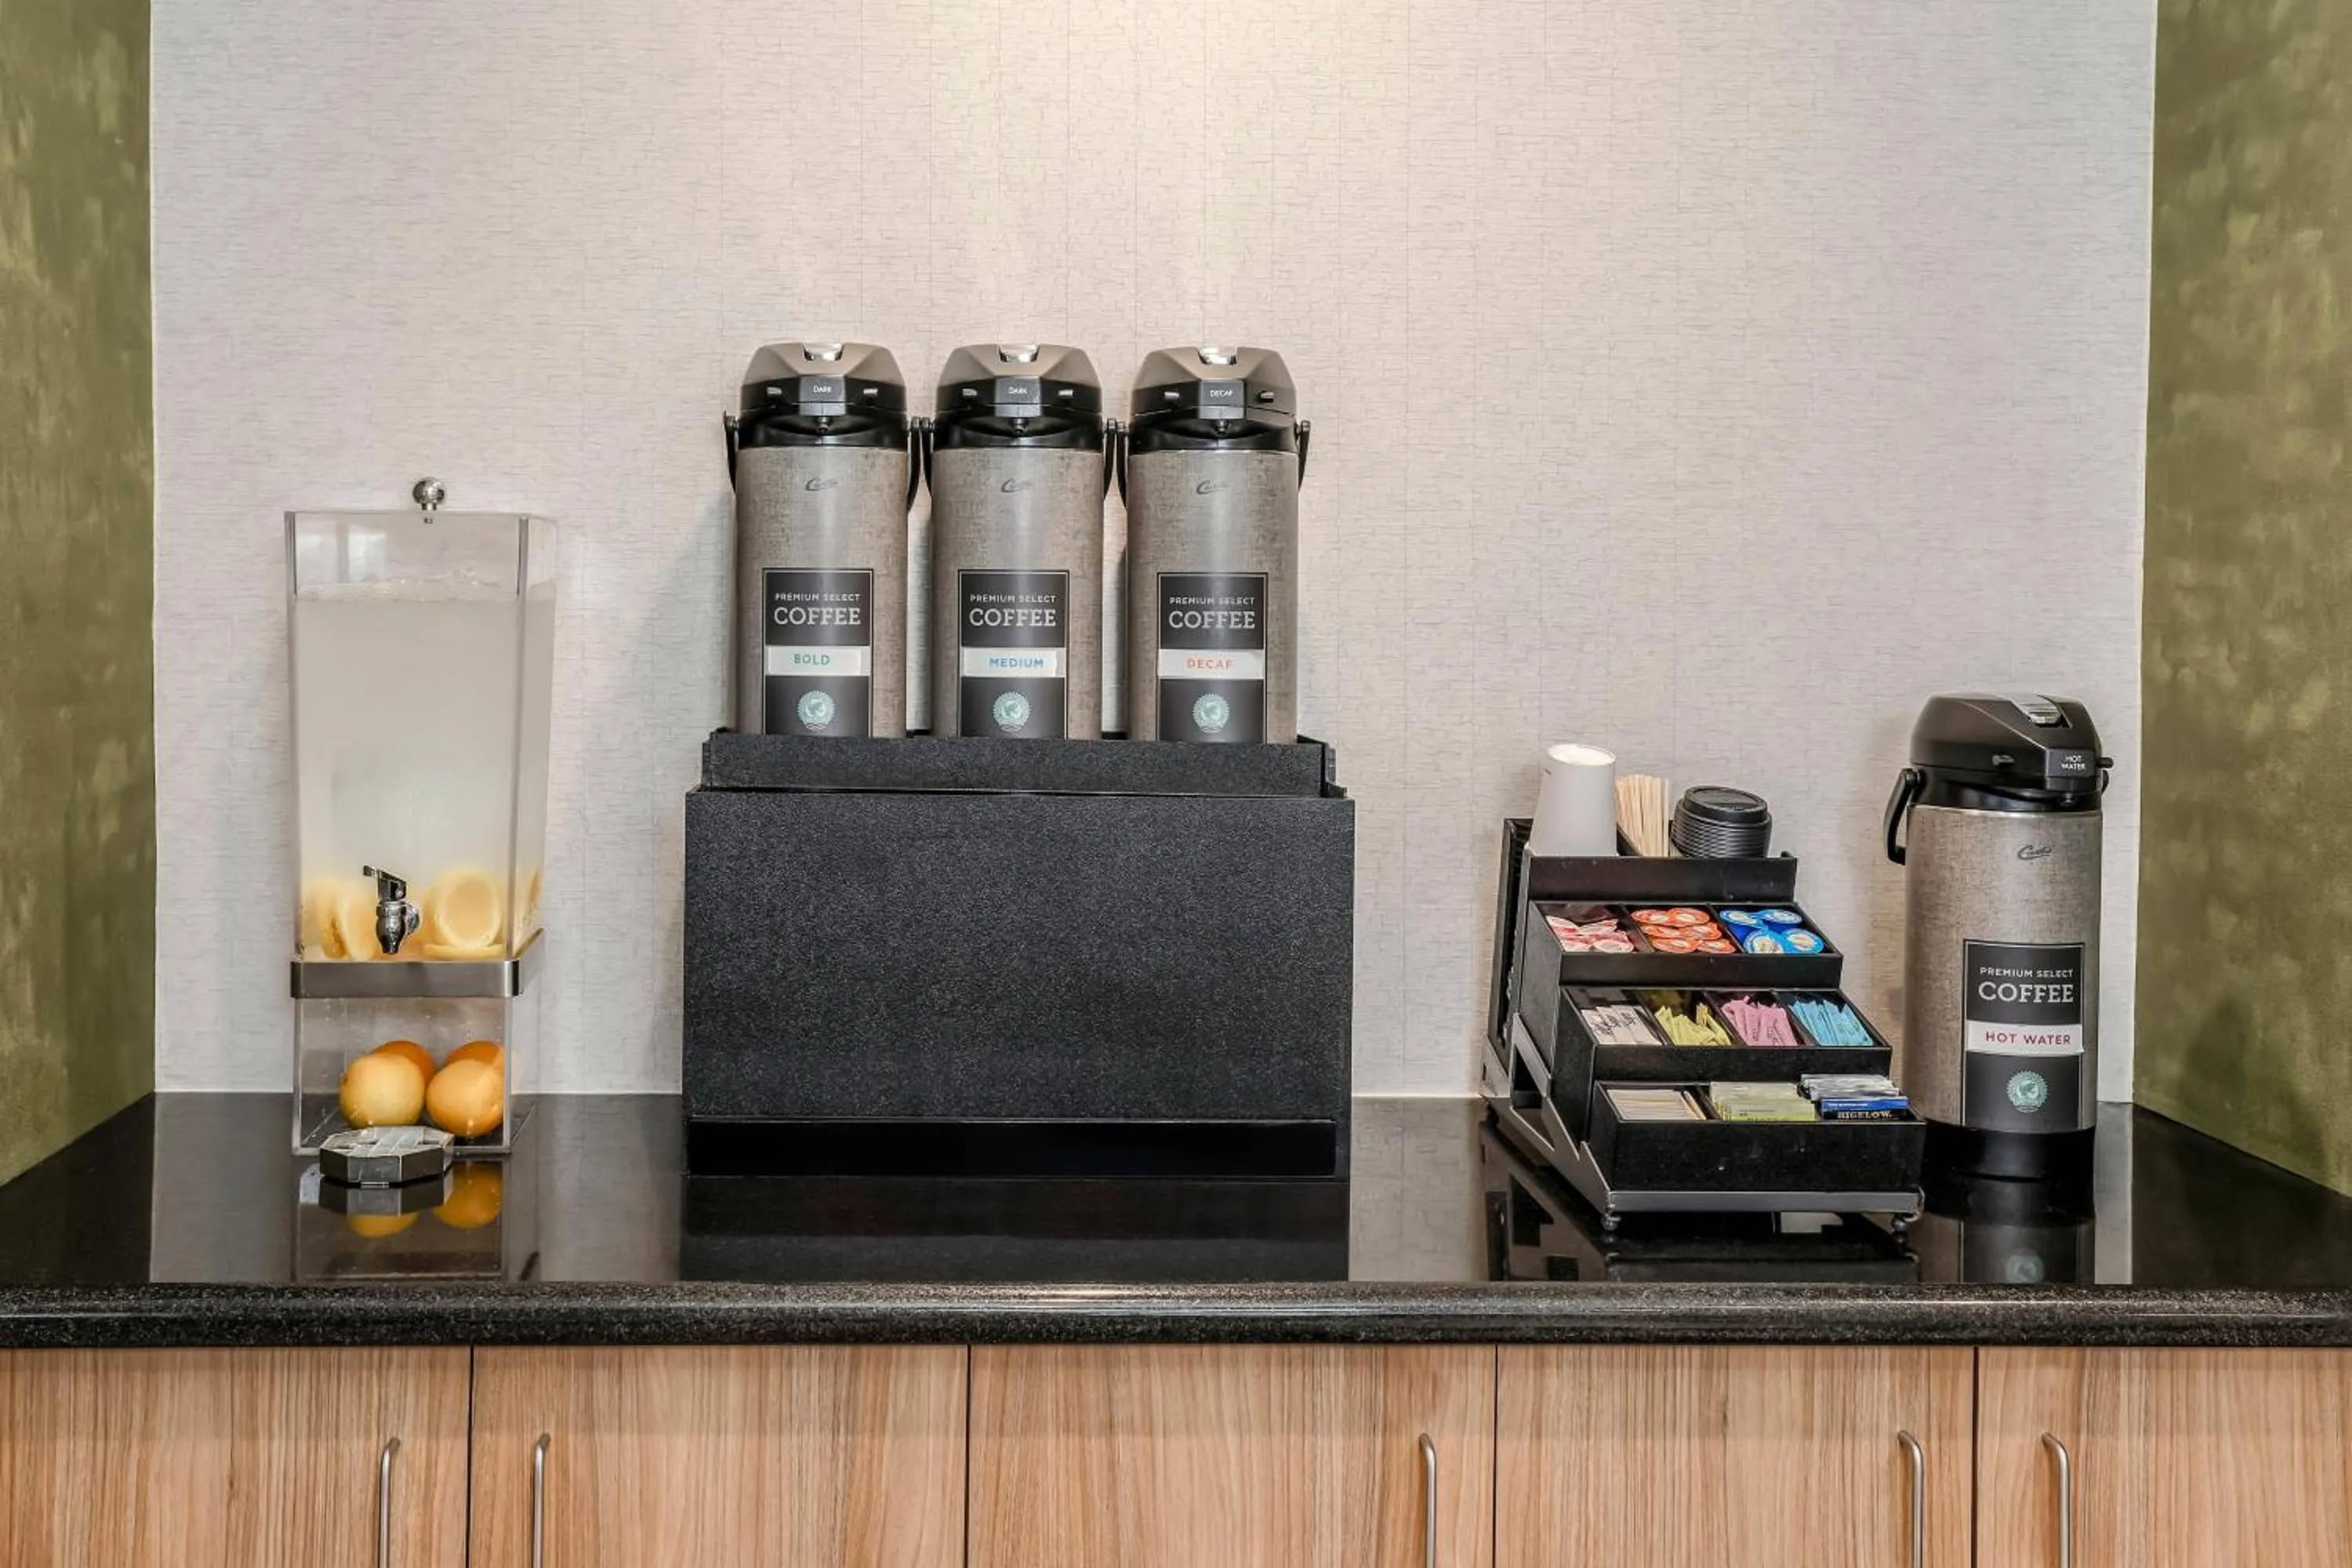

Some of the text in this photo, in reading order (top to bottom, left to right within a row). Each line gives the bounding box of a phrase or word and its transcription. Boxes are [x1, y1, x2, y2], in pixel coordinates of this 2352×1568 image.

[1210, 390, 1233, 398] DECAF
[775, 593, 862, 602] PREMIUM SELECT
[970, 593, 1058, 603] PREMIUM SELECT
[774, 607, 861, 626] COFFEE
[969, 608, 1057, 626] COFFEE
[1168, 611, 1255, 629] COFFEE
[793, 654, 831, 666] BOLD
[989, 657, 1044, 667] MEDIUM
[1186, 659, 1234, 670] DECAF
[1980, 967, 2074, 978] PREMIUM SELECT
[1978, 982, 2074, 1003] COFFEE
[1986, 1031, 2071, 1045] HOT WATER
